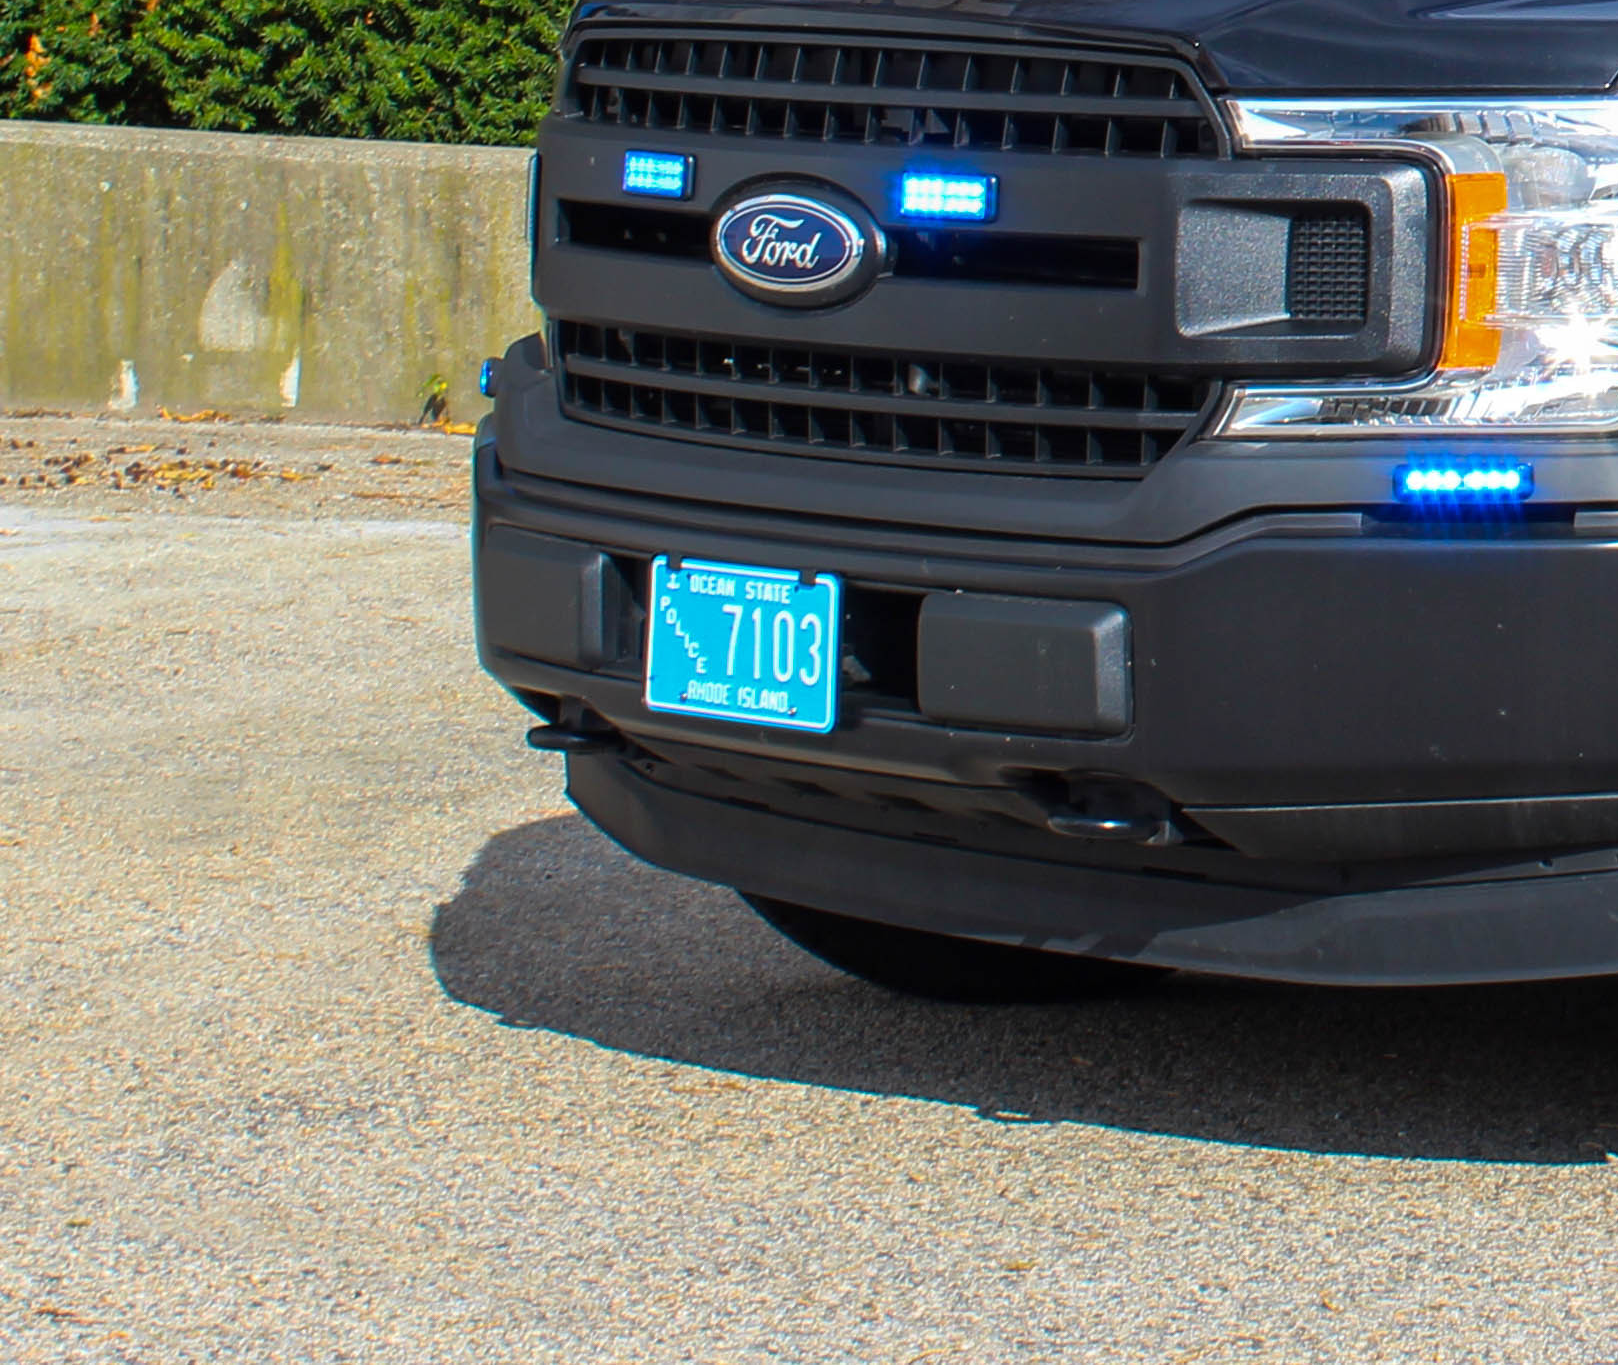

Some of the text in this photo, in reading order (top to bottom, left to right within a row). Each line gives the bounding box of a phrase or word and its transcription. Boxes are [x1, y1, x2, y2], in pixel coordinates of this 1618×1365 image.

[742, 214, 821, 269] Ford
[689, 574, 791, 604] OCEAN STATE
[660, 595, 708, 674] POLICE
[722, 603, 823, 686] 7103
[687, 680, 789, 714] RHODE ISLAND
